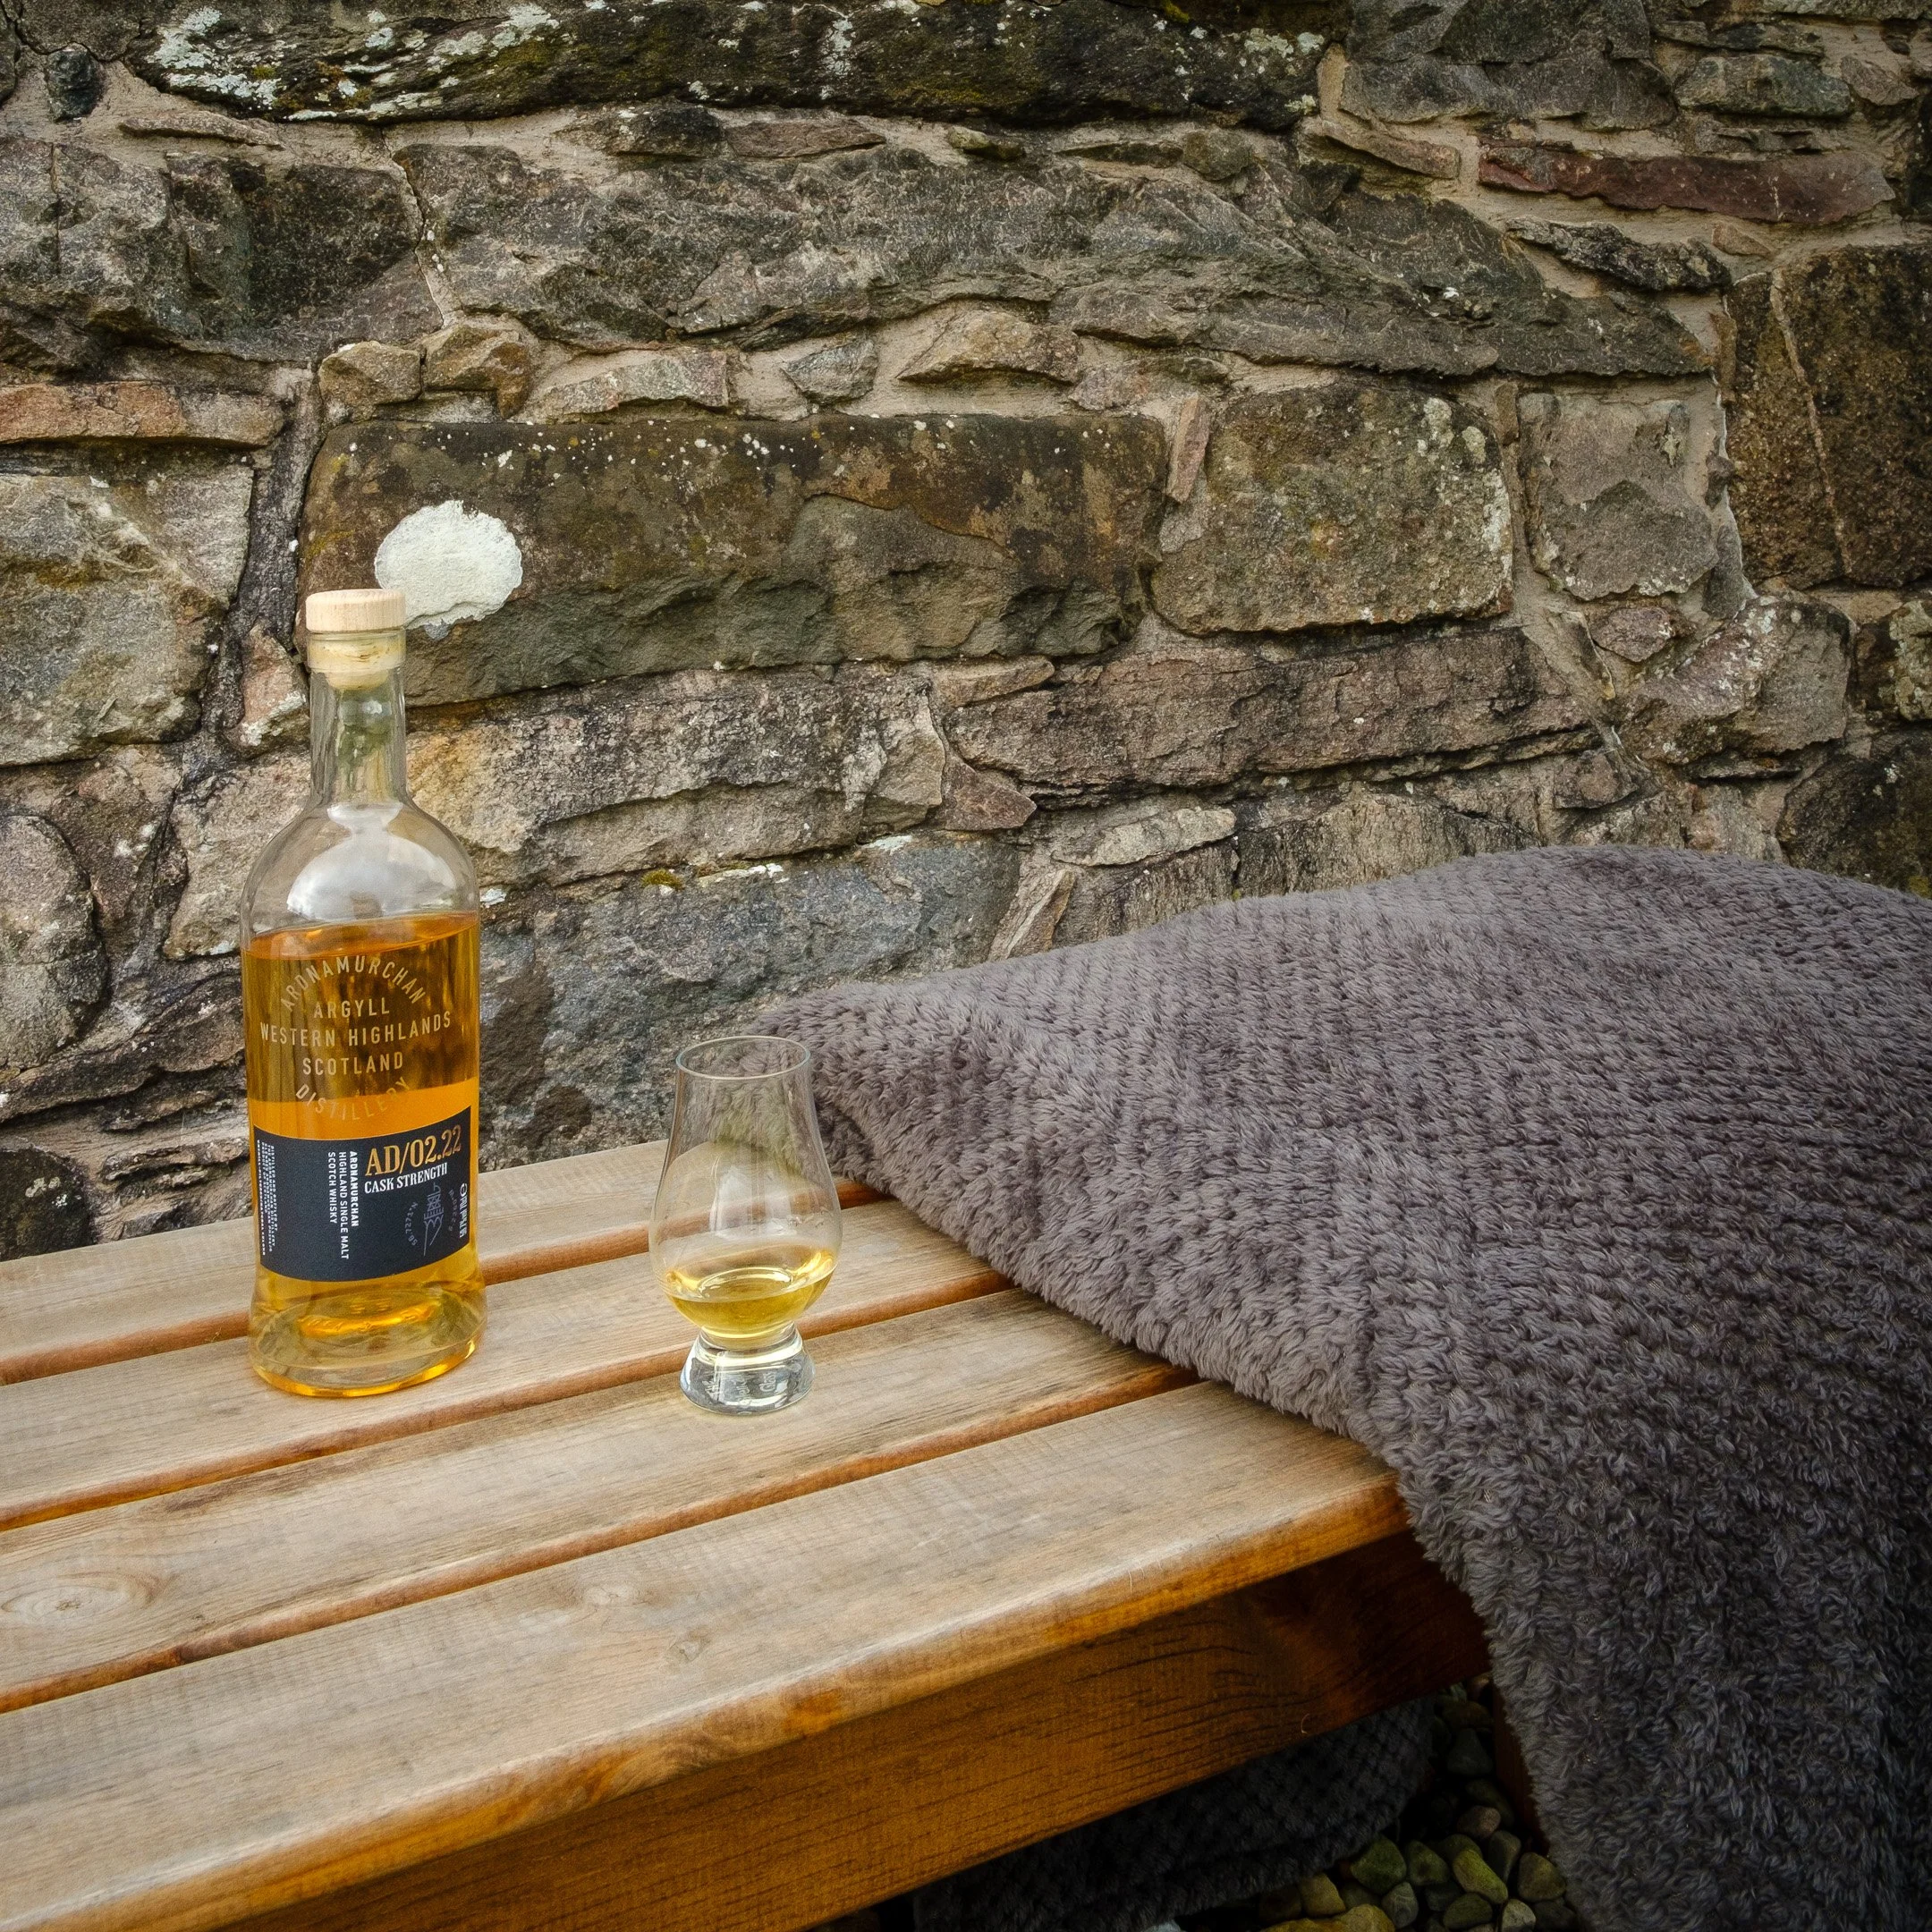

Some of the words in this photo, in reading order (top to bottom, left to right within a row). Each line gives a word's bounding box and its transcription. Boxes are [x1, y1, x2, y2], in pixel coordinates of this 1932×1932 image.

[280, 955, 426, 1013] ARDNAMURCHAN
[313, 996, 390, 1019] ARGYLL
[260, 1021, 335, 1046] WESTERN
[348, 1010, 451, 1046] HIGHLANDS
[302, 1051, 403, 1075] SCOTLAND
[296, 1076, 411, 1121] DISTILLERY
[365, 1124, 462, 1176] AD/02.22
[328, 1151, 336, 1187] SCOTCH
[339, 1151, 347, 1199] HIGHLAND
[364, 1177, 394, 1194] CASK
[396, 1162, 447, 1189] STRENGTH
[329, 1189, 337, 1224] WHISKY
[350, 1150, 359, 1227] ARDNAMURCHAN
[340, 1200, 348, 1233] SINGLE
[341, 1235, 349, 1259] MALT
